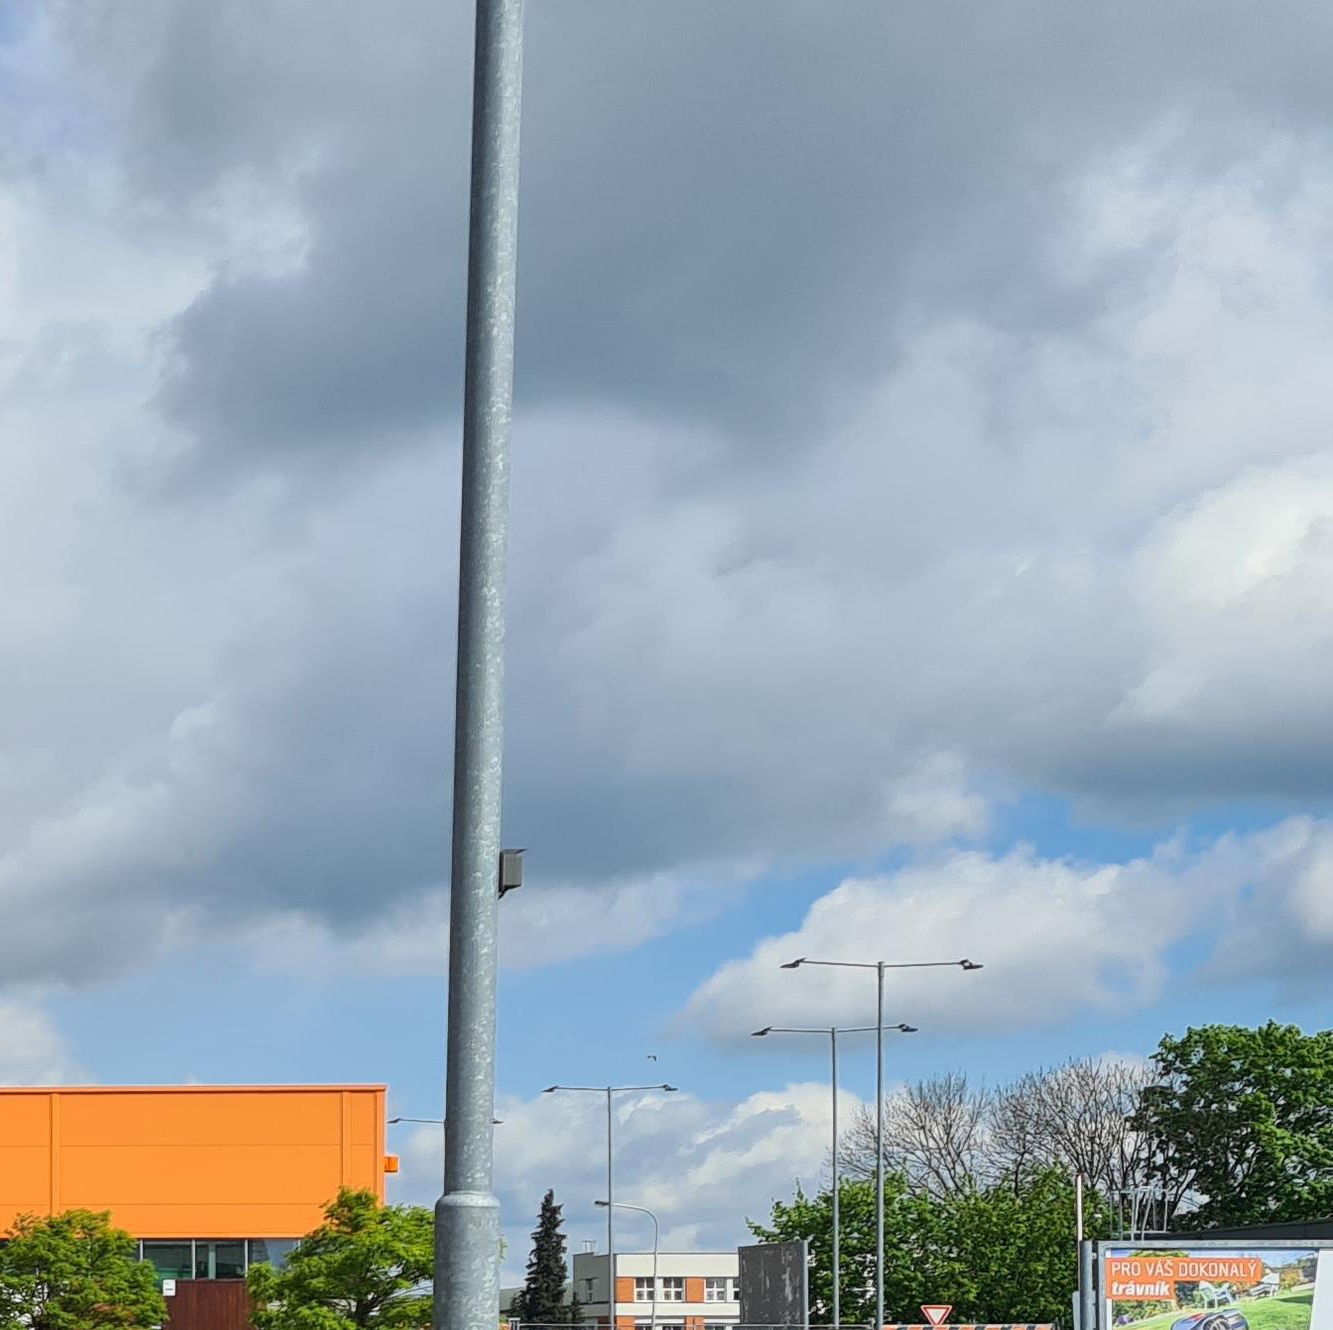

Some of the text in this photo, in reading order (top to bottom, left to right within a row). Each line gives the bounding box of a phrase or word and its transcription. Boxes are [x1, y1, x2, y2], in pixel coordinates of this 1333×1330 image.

[1111, 1258, 1257, 1277] PRO VÁŠ DOKONALÝ
[1111, 1279, 1170, 1296] trávník
